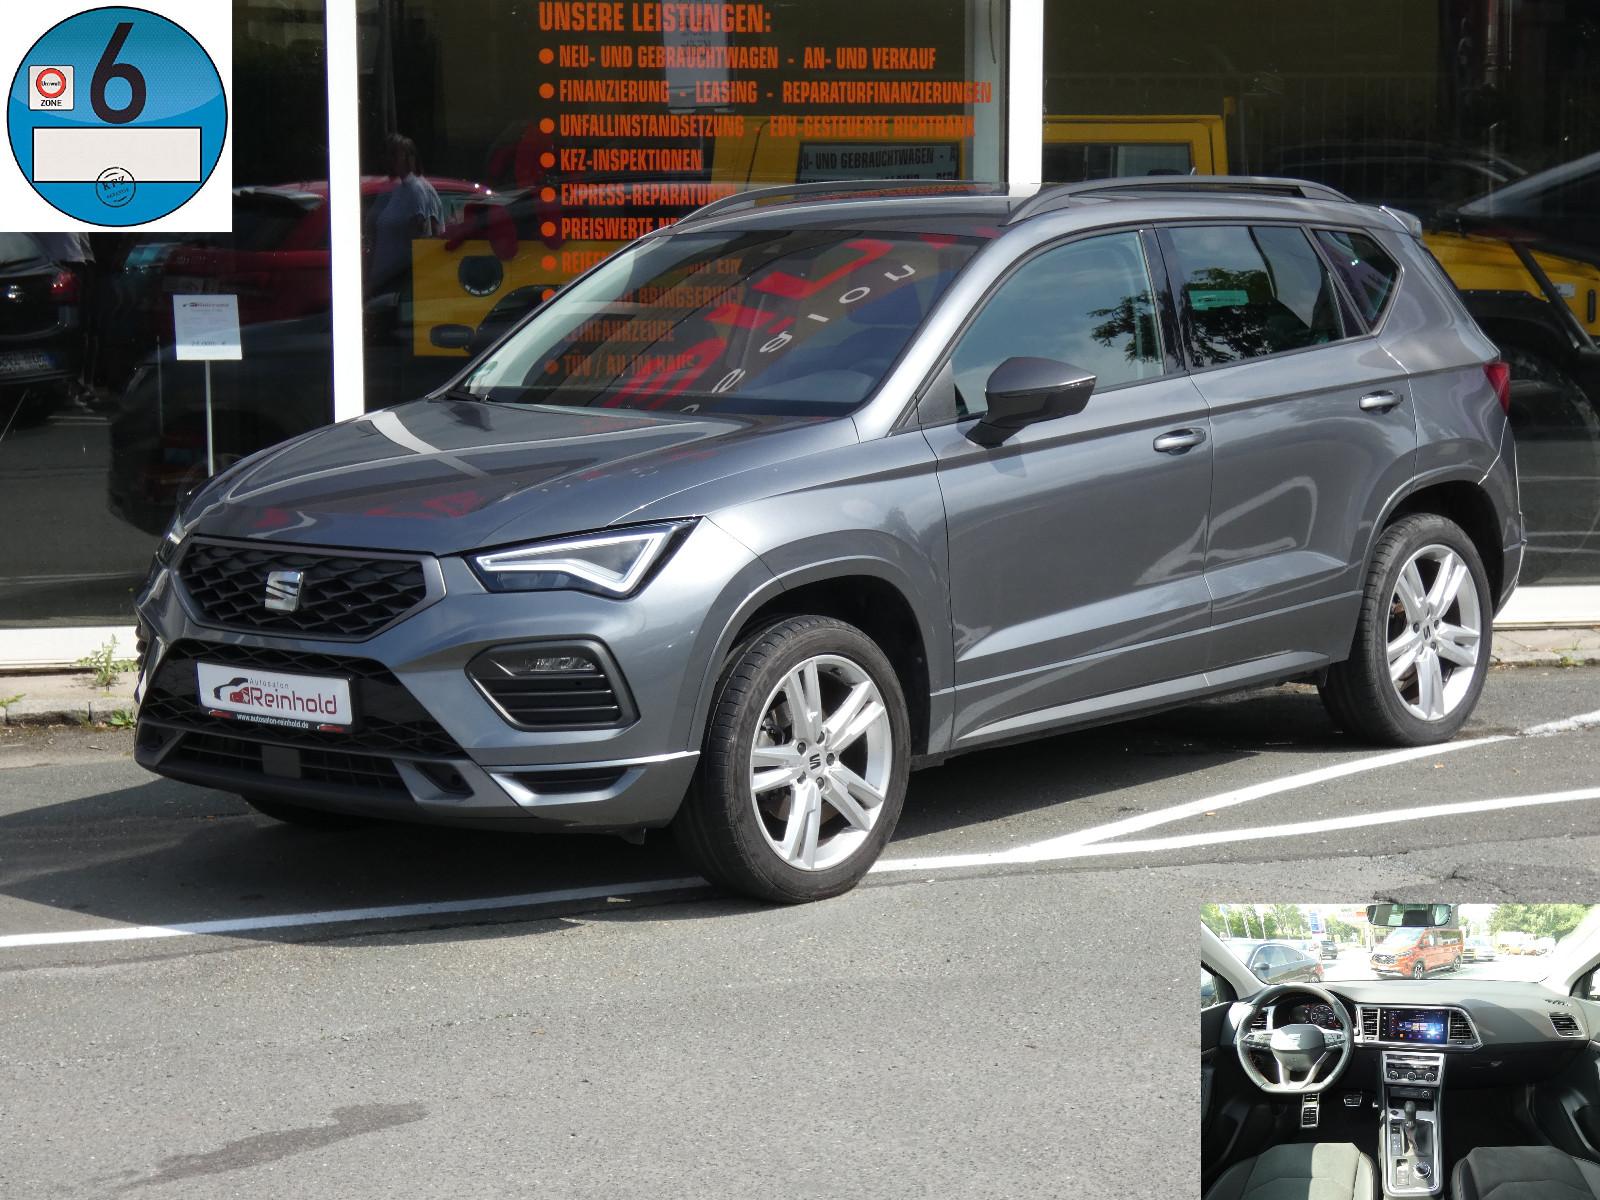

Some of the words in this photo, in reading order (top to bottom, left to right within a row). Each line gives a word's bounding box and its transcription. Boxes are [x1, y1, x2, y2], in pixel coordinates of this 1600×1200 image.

[539, 2, 625, 32] UNSERE
[632, 2, 771, 33] LEISTUNGEN:
[559, 46, 596, 68] NEU-
[600, 46, 633, 68] UND
[637, 46, 779, 69] GEBRAUCHTWAGEN
[803, 47, 831, 69] AN-
[836, 48, 868, 69] UND
[872, 48, 936, 70] VERKAUF
[559, 80, 670, 103] FINANZIERUNG
[695, 80, 758, 103] LEASING
[782, 81, 993, 104] REPARATURFINANZIERUNGEN
[560, 115, 745, 138] UNFALLINSTANDSETZUNG
[769, 115, 889, 138] EDV-GESTEUERTE
[892, 115, 976, 138] RICHTBANK
[560, 148, 703, 171] KFZ-INSPEKTIONEN
[816, 151, 837, 170] UND
[840, 148, 934, 169] GEBRAUCHTWAGEN
[561, 217, 654, 240] PREISWERTE
[249, 677, 289, 688] Autosalon
[250, 687, 337, 714] Reinhold
[236, 713, 309, 729] www.autosalon-reinhold.de
